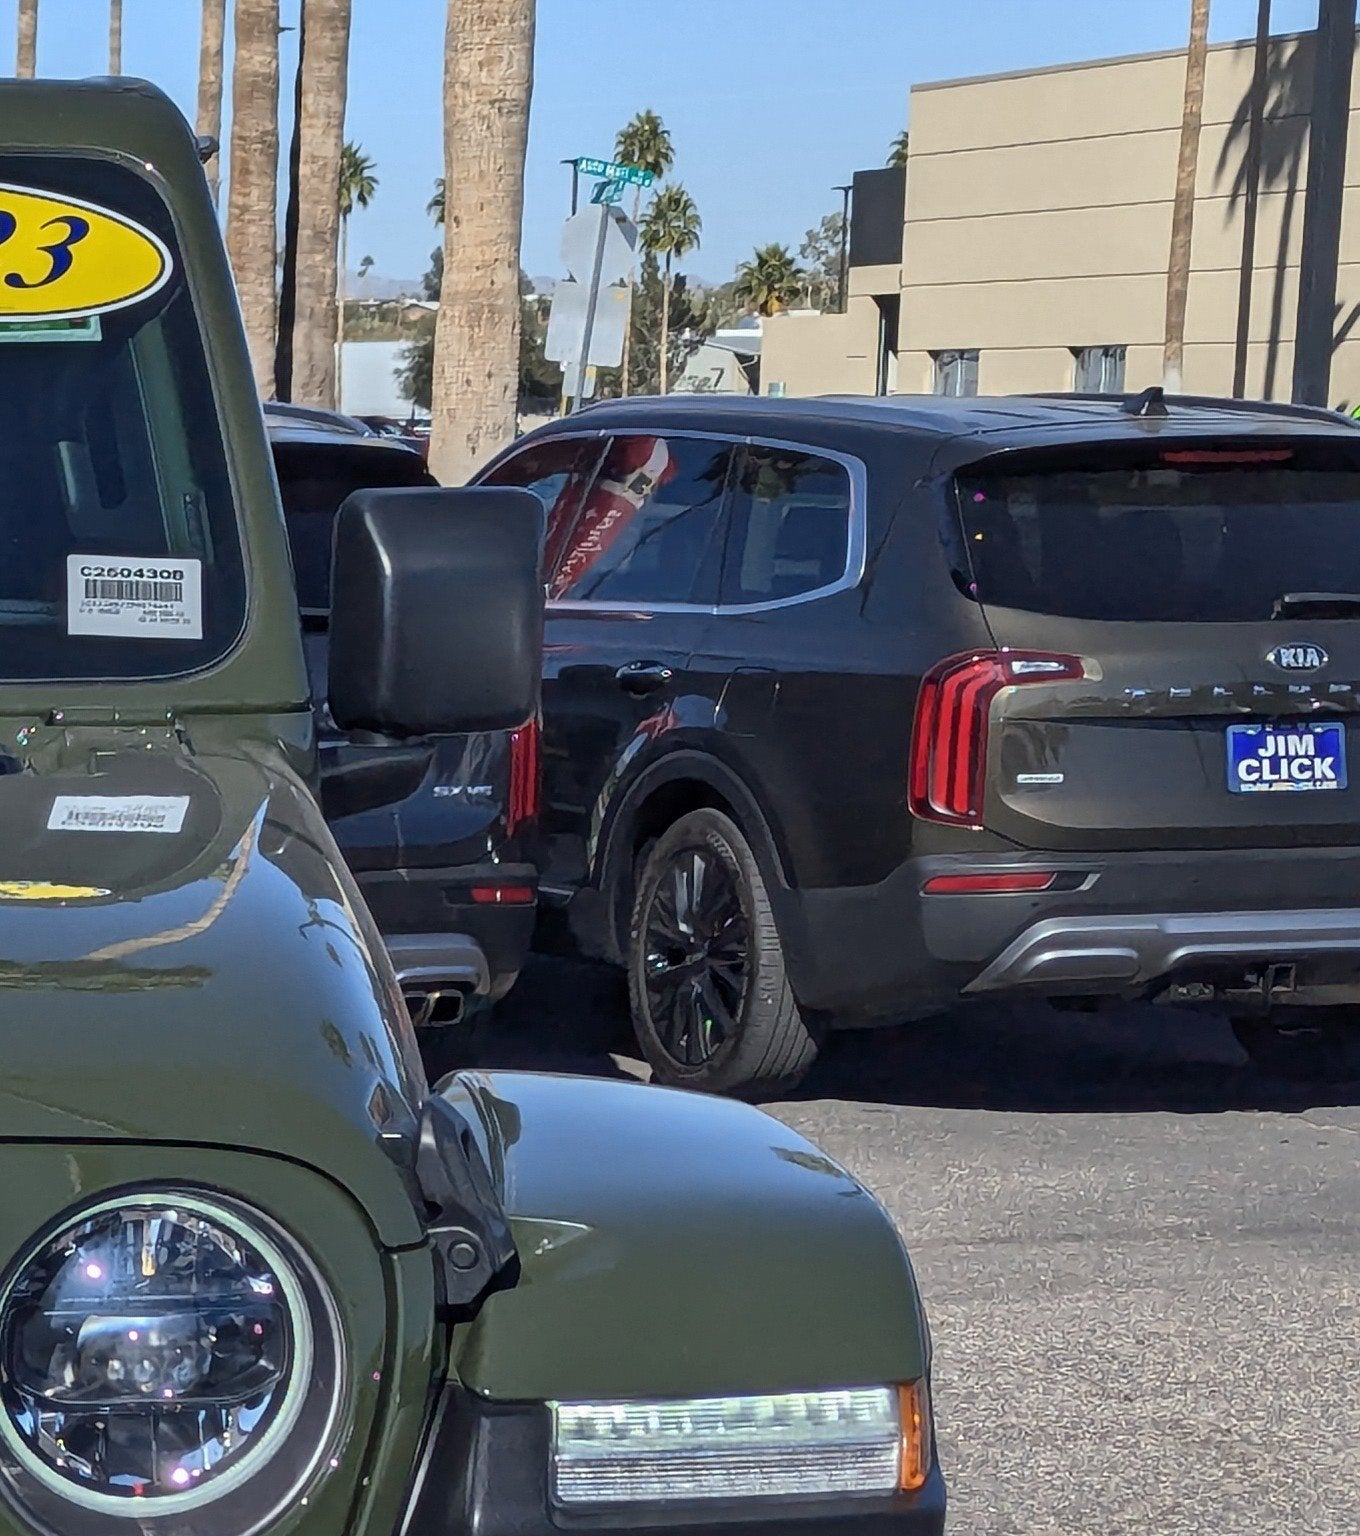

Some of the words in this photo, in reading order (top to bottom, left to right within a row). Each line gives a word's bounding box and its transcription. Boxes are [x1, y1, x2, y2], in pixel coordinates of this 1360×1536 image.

[1279, 647, 1320, 668] KIA
[1258, 734, 1316, 757] JIM
[1237, 757, 1336, 782] CLICK
